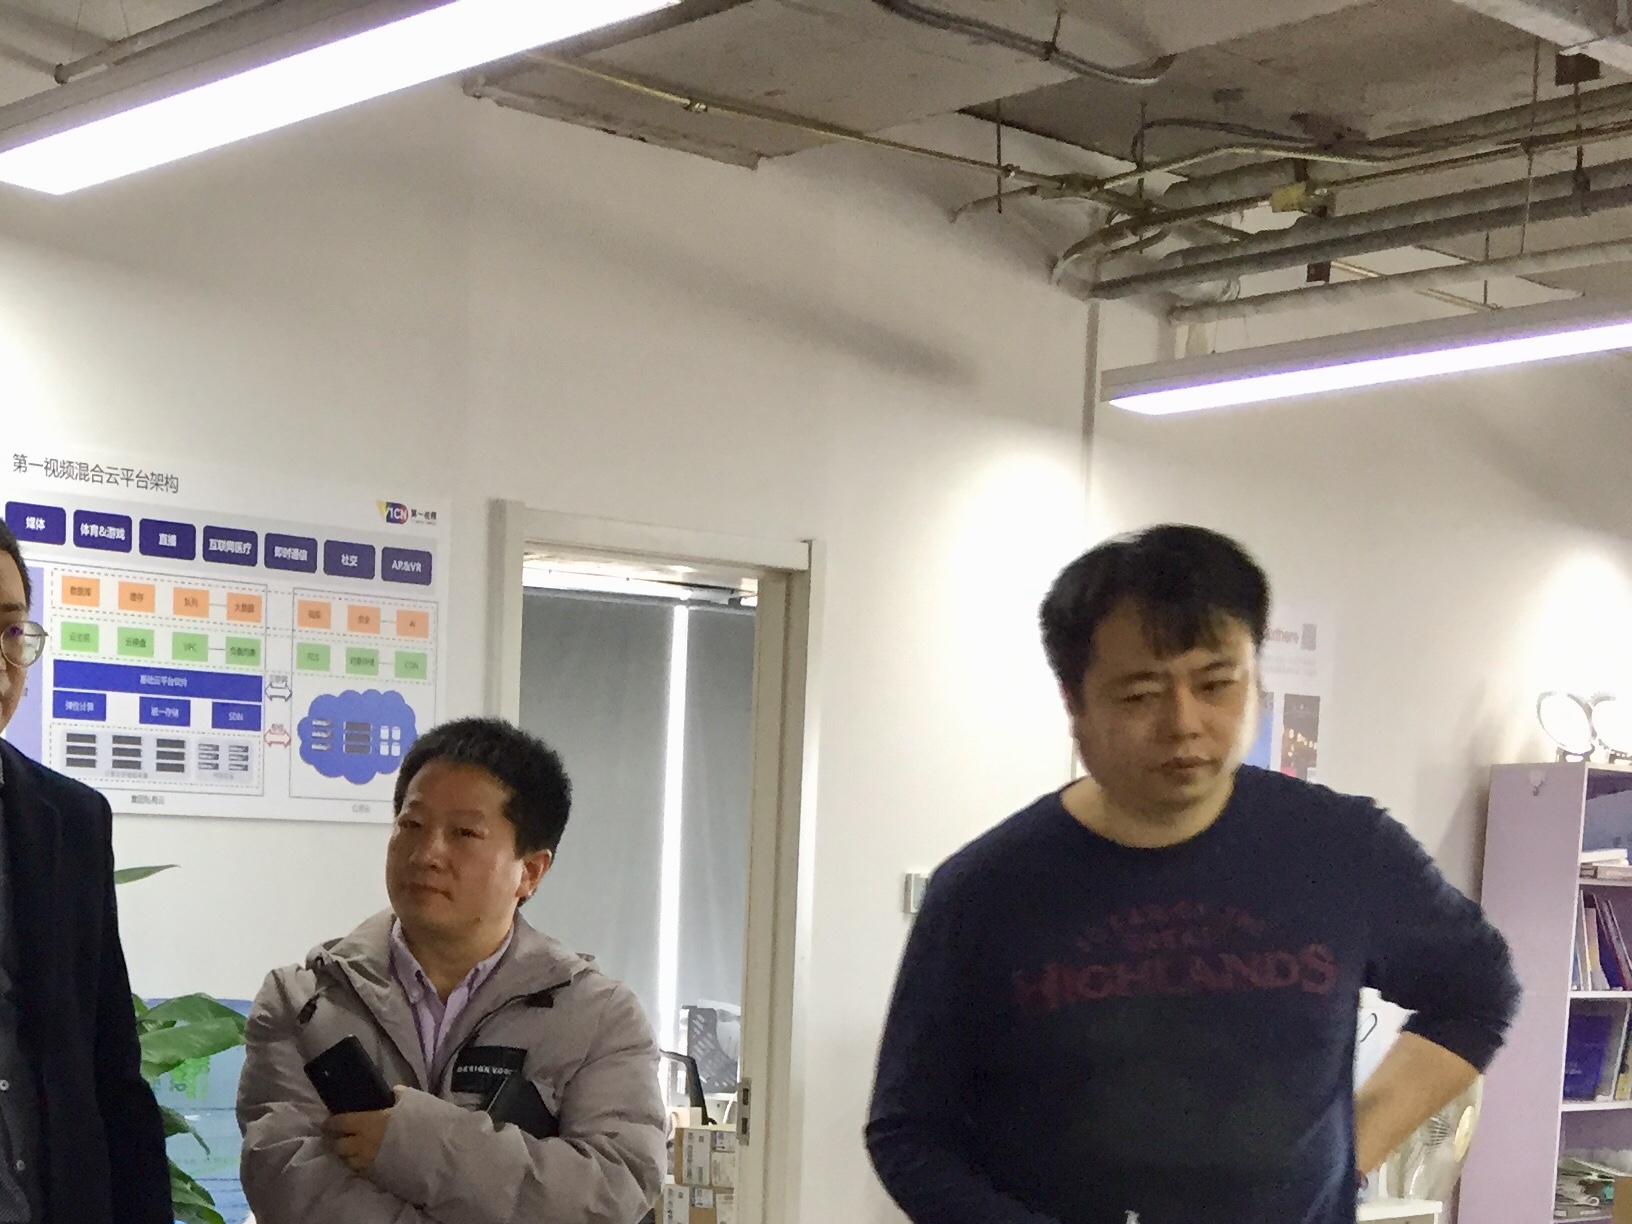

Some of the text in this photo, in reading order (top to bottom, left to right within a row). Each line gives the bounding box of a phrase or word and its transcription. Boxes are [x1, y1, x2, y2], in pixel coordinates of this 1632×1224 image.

[12, 453, 180, 494] 第一视频混合云平台架构
